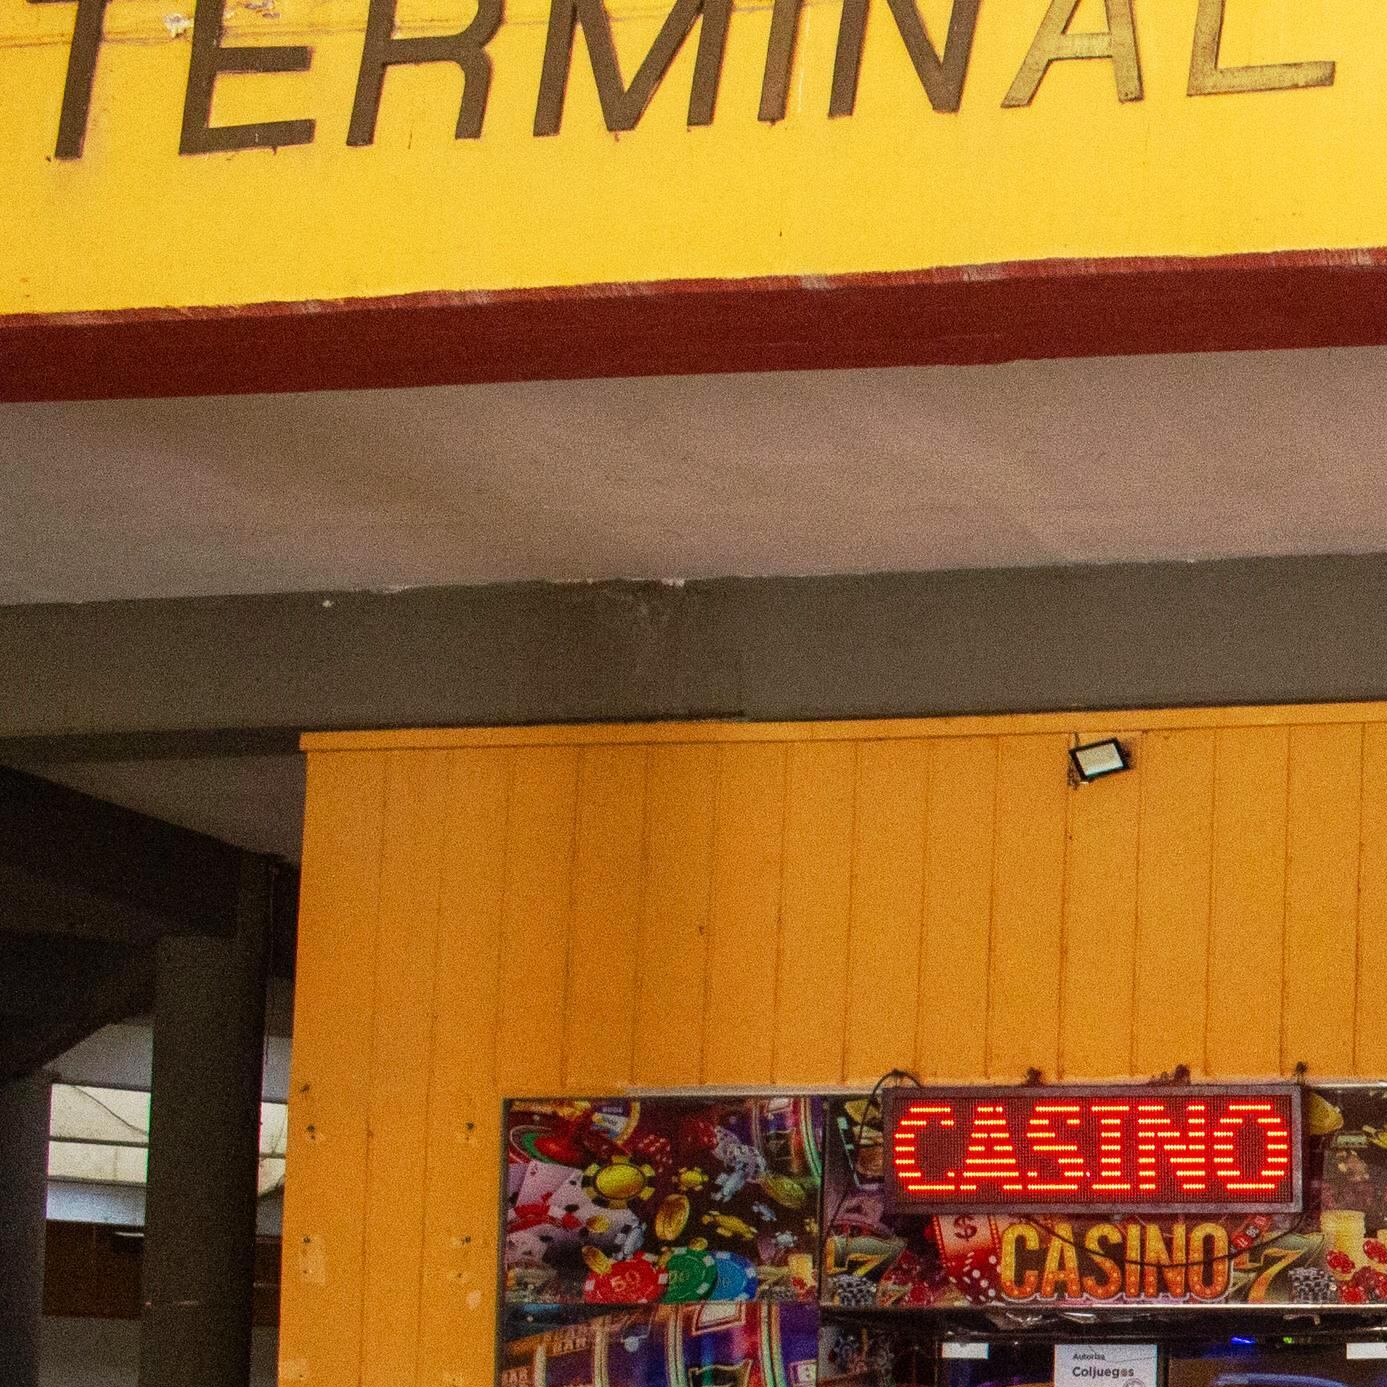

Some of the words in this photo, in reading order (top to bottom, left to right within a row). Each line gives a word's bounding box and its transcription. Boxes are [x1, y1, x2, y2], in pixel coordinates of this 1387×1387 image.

[893, 1104, 1288, 1191] CASINO
[1000, 1221, 1231, 1302] CASINO
[1072, 1366, 1134, 1378] Coljuegos
